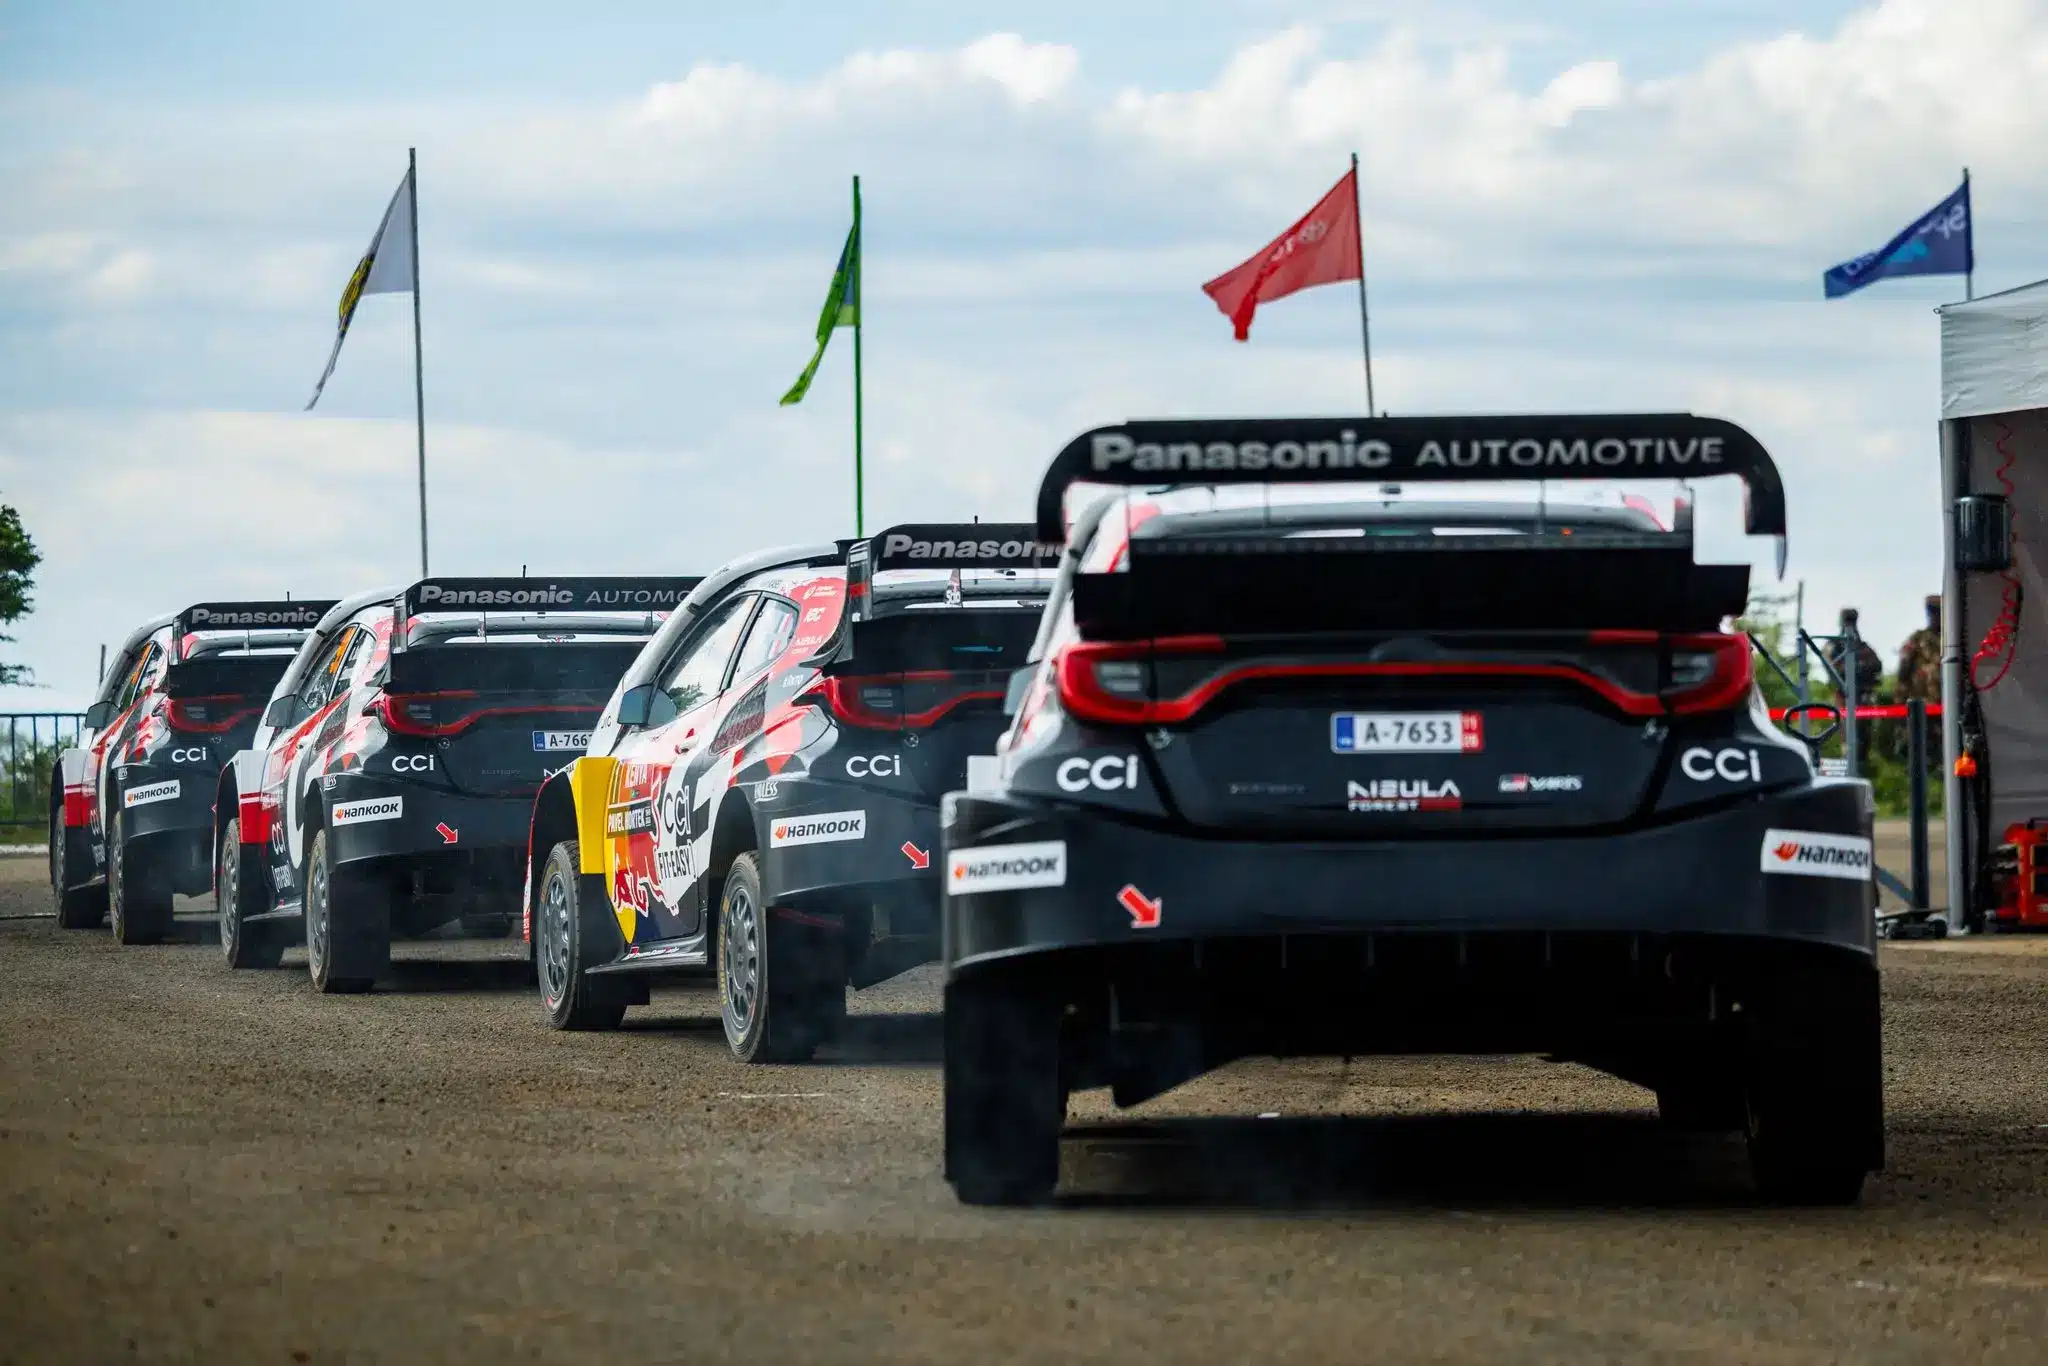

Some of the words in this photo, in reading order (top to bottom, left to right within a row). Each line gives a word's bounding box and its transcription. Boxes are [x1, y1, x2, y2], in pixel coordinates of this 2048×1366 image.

[1091, 431, 1392, 471] Panasonic
[1415, 437, 1723, 466] AUTOMOTIVE
[420, 585, 574, 605] Panasonic
[192, 607, 319, 624] Panasonic
[1364, 721, 1454, 744] A-7653
